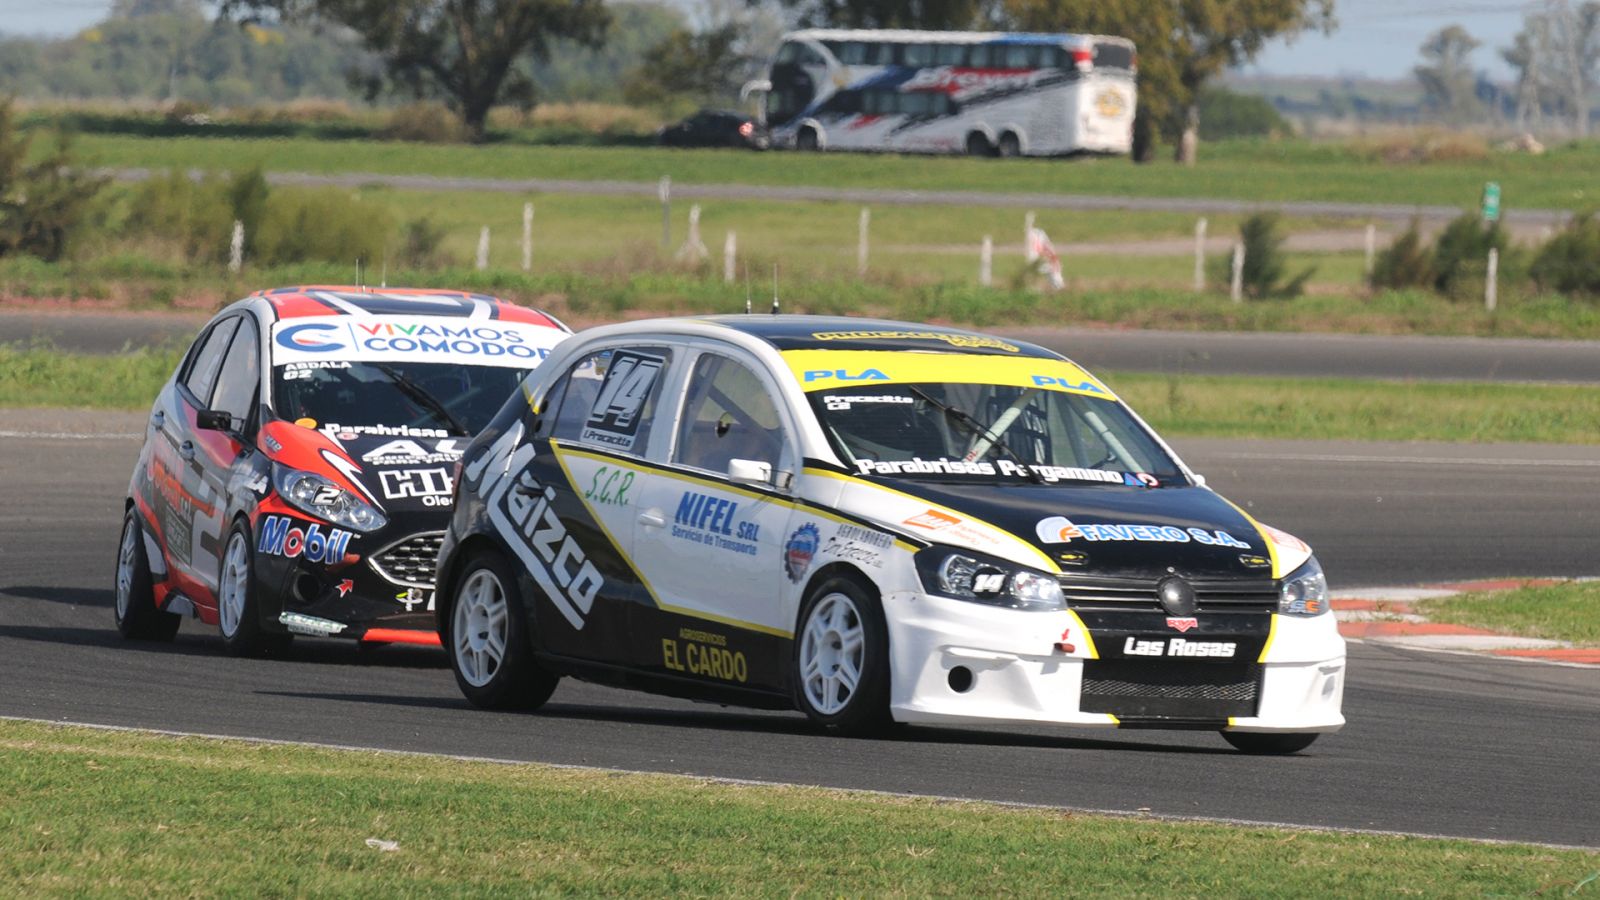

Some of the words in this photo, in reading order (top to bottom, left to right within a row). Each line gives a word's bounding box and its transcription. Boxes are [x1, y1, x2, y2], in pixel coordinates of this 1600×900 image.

[358, 322, 524, 343] VIVAMOS
[285, 361, 352, 371] ABDALA
[804, 368, 890, 382] PLA
[592, 356, 661, 427] 14
[1030, 375, 1108, 394] PLA
[856, 457, 996, 476] Parabrisas
[314, 487, 341, 505] 2
[674, 491, 738, 535] NIFEL
[736, 520, 760, 542] SRL
[258, 515, 353, 565] Mobil
[671, 524, 703, 544] Servicio
[703, 533, 715, 546] de
[714, 535, 758, 557] Transporte
[1079, 523, 1191, 543] FAVERO
[1190, 528, 1252, 549] S.A.
[972, 574, 1006, 592] 14
[1123, 636, 1165, 657] Las
[1167, 637, 1238, 658] Rosas
[662, 638, 684, 671] EL
[686, 643, 747, 683] CARDO
